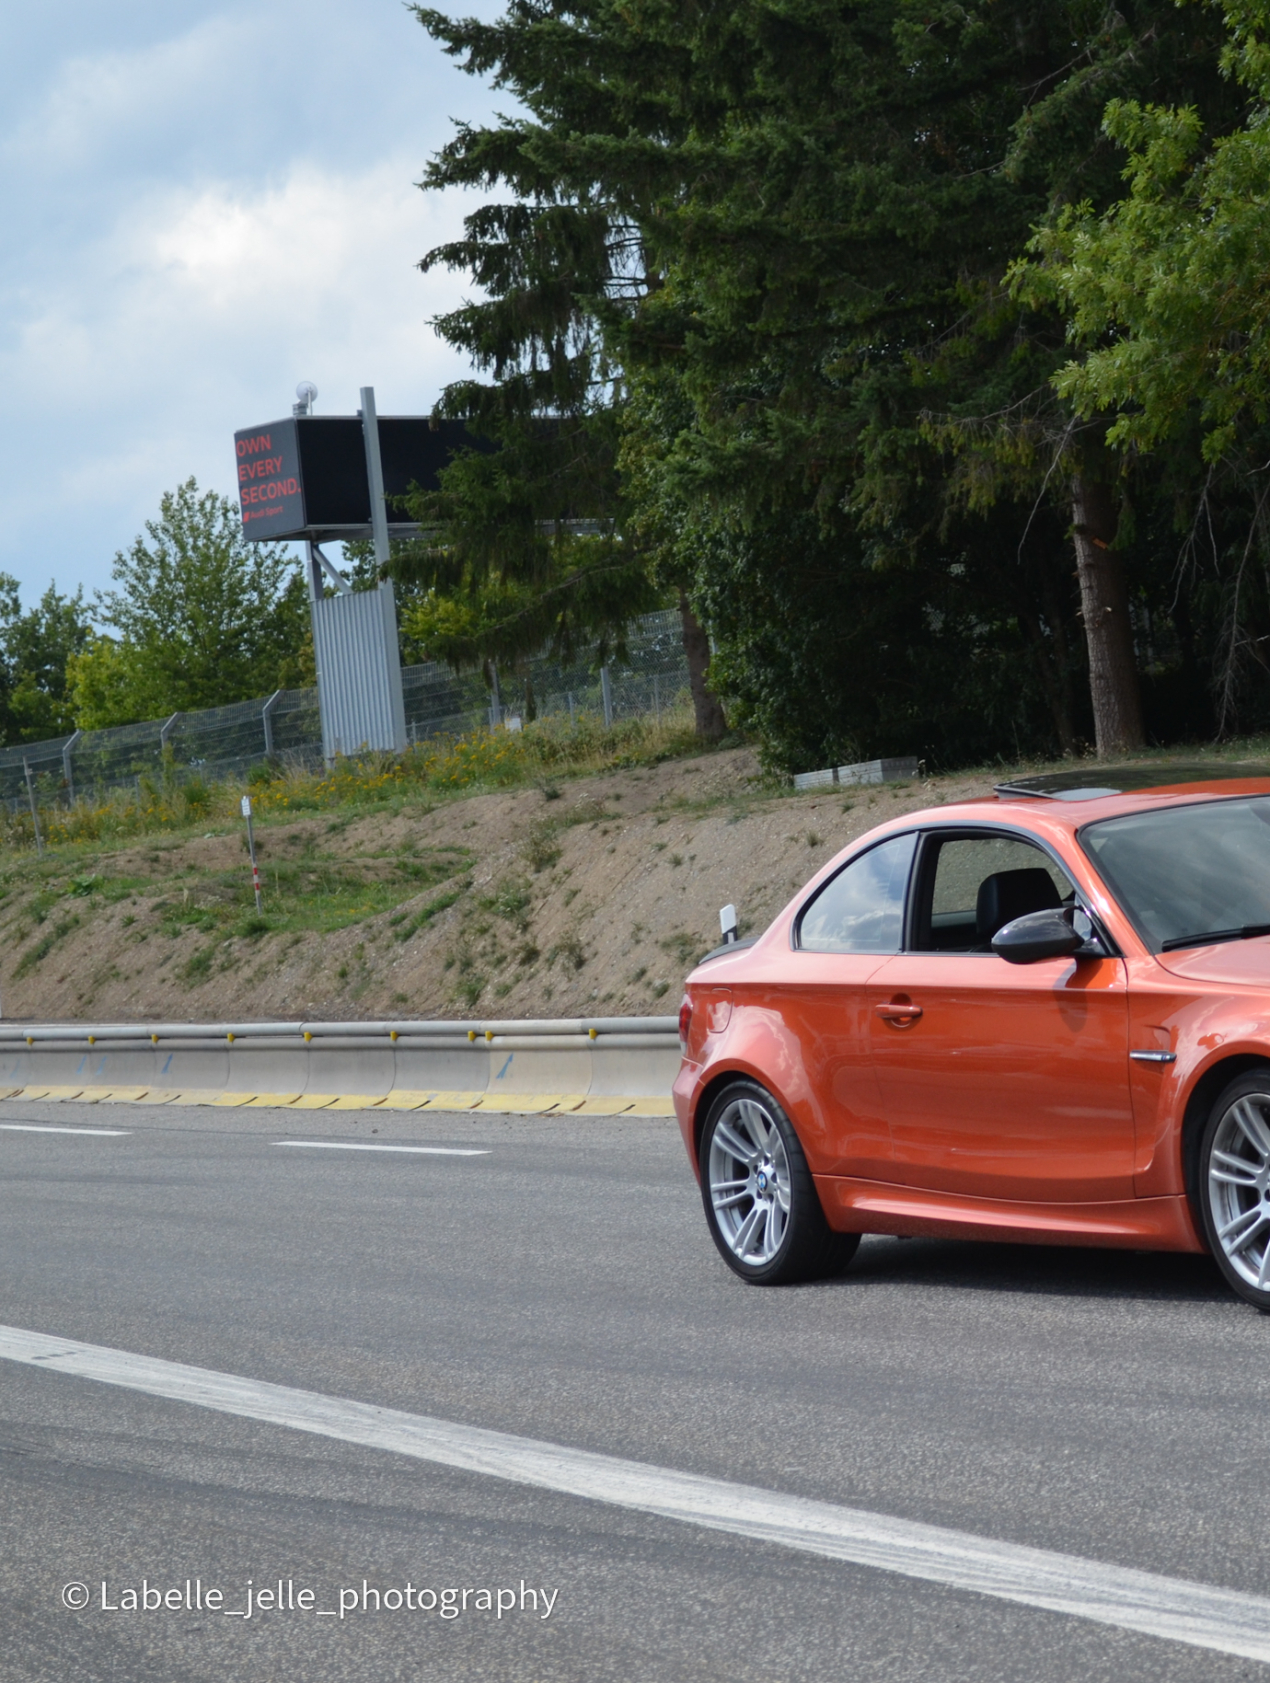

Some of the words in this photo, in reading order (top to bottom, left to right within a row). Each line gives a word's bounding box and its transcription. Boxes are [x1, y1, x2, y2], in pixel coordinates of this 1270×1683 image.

[236, 434, 272, 457] OWN
[238, 456, 283, 481] EVERY
[240, 477, 302, 506] SECOND.
